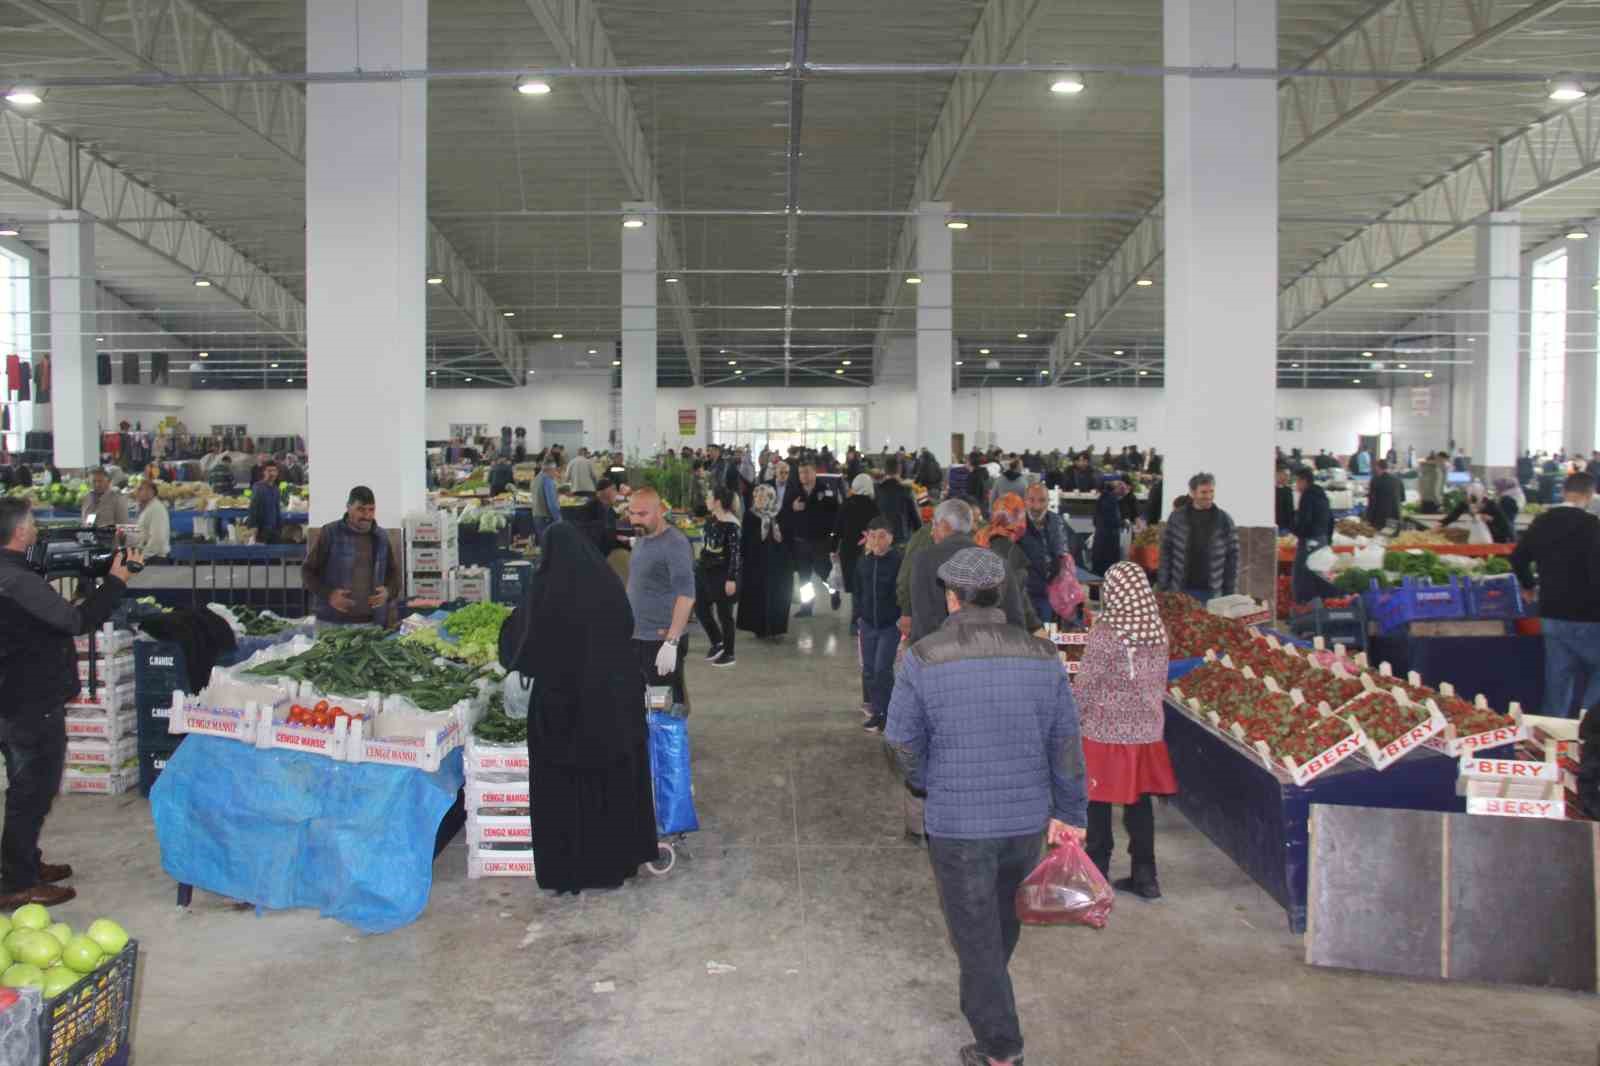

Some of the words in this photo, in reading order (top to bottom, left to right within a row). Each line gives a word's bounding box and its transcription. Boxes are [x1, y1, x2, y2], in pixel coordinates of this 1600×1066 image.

[1386, 719, 1433, 757] BERY
[1465, 725, 1520, 746] BERY
[1308, 732, 1361, 774] BERY
[1478, 761, 1543, 777] BERY
[1487, 800, 1552, 816] BERY
